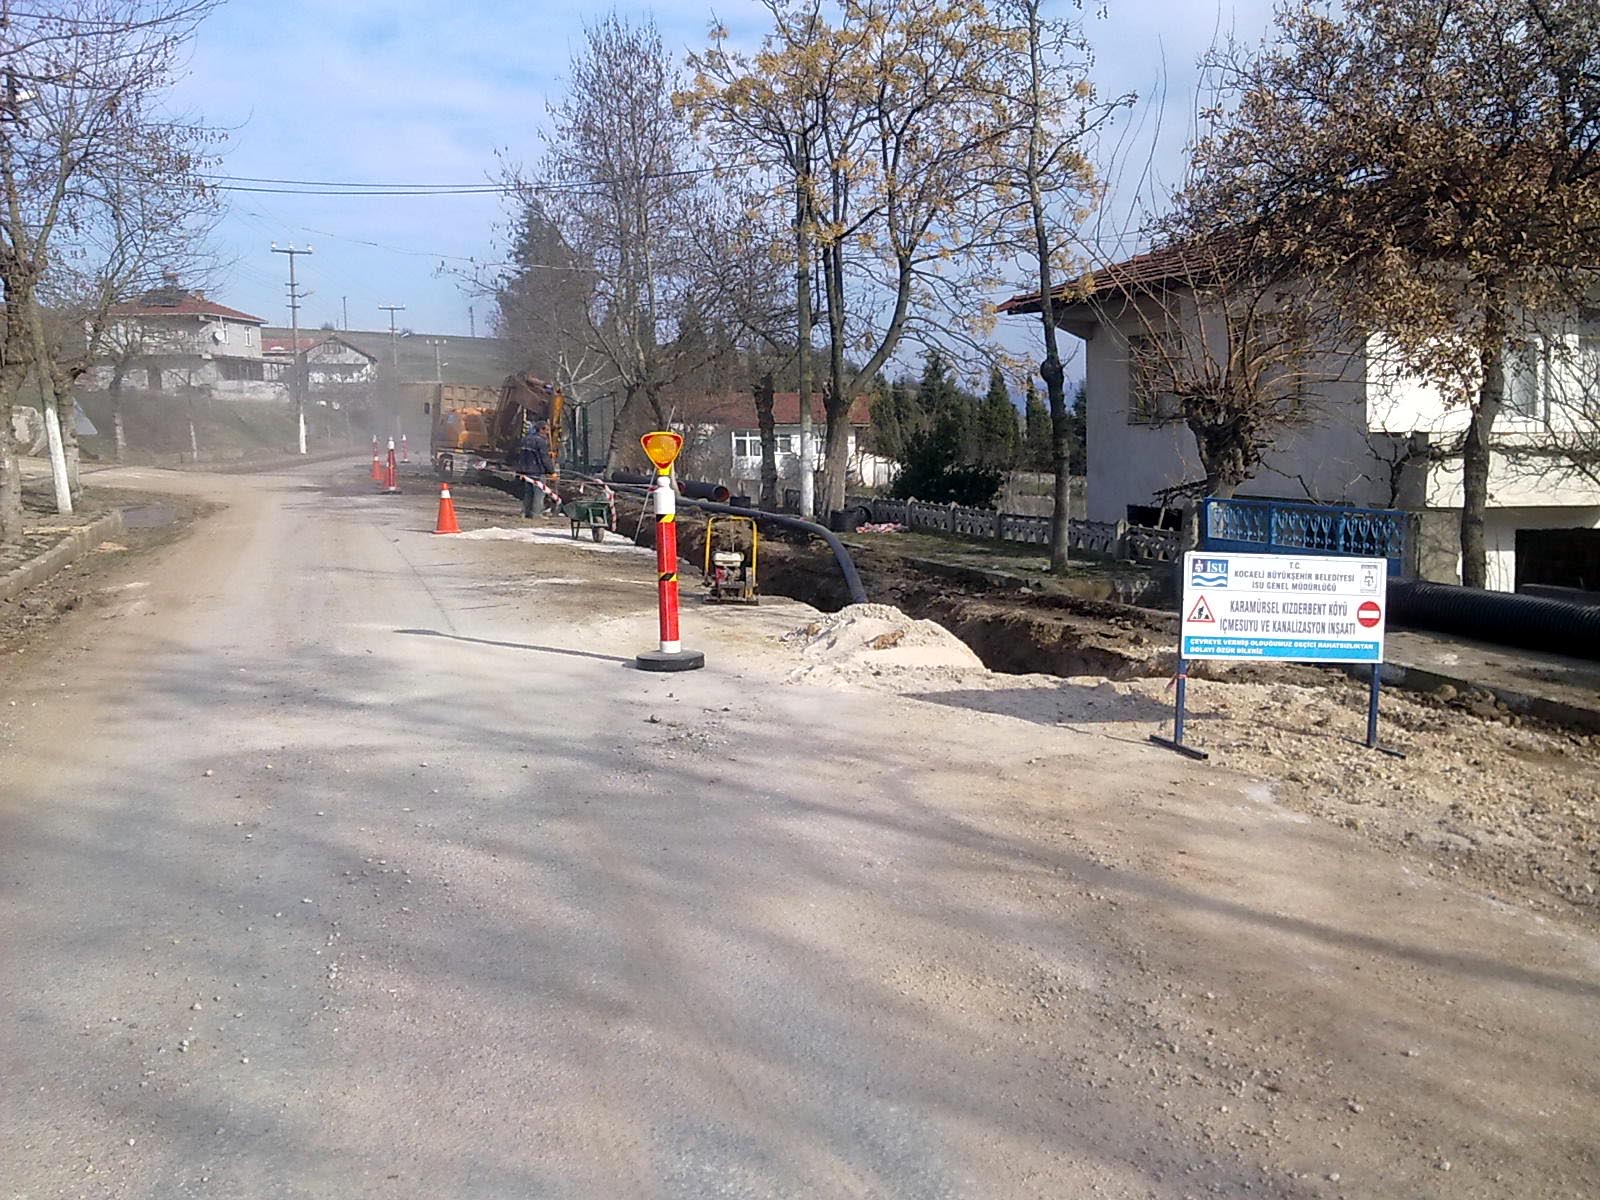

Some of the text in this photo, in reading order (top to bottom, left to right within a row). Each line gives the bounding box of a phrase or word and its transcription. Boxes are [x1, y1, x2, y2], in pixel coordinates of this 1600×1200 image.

[1206, 560, 1226, 572] İSU
[1234, 570, 1354, 582] KOCAELİ BÜYÜKŞEHİR BELEDİYESİ
[1252, 581, 1336, 592] İSU GENEL MÜDÜRLÜĞÜ
[1230, 598, 1348, 616] KARAMÜRSEL KIZDERBENT KÖYÜ
[1220, 616, 1356, 638] İÇMESUYU VE KANALİZASYON İNŞAATI
